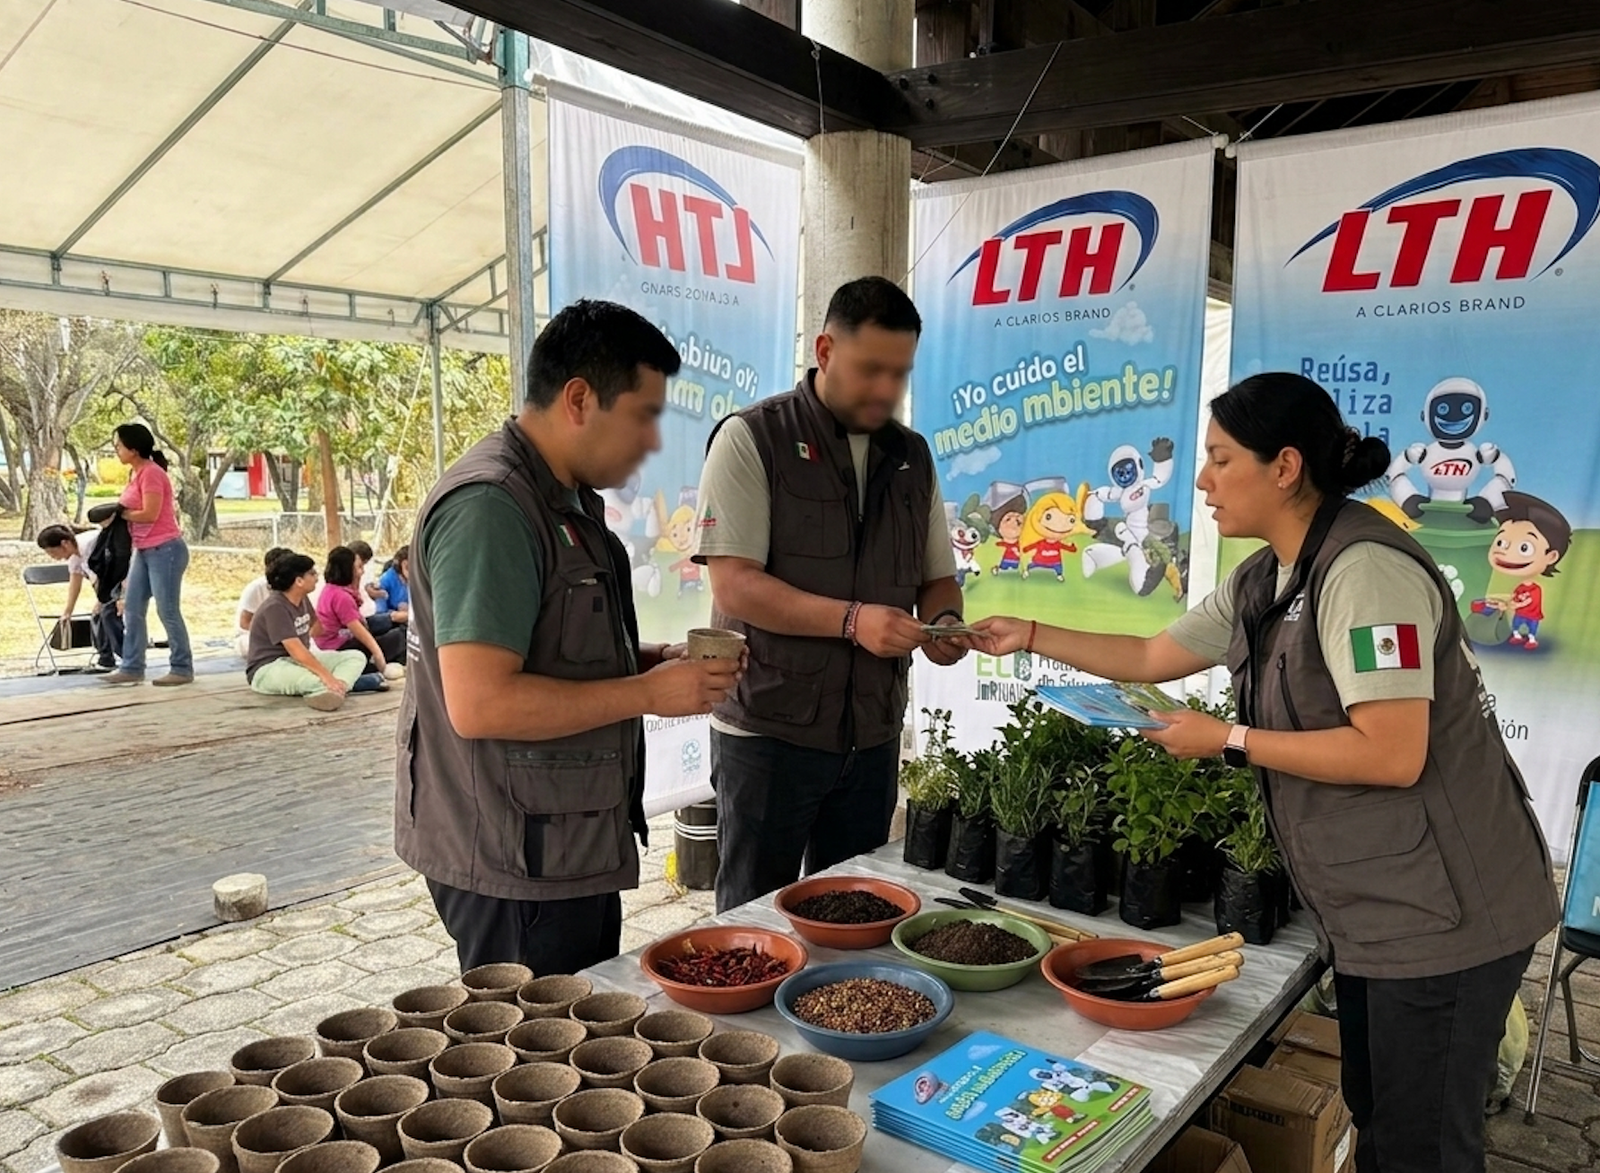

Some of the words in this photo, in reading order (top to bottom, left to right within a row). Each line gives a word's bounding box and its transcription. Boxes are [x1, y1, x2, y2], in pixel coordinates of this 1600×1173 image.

[1322, 189, 1553, 293] LTH
[972, 222, 1125, 306] LTH
[994, 318, 1002, 328] A
[1006, 312, 1060, 327] CLARIOS
[1065, 307, 1111, 322] BRAND
[1356, 306, 1367, 318] A
[1374, 301, 1451, 317] CLARIOS
[1460, 296, 1525, 312] BRAND
[1063, 345, 1085, 373] el
[1301, 354, 1390, 386] Reúsa,
[934, 404, 1018, 455] medio
[1023, 364, 1173, 424] mbiente!
[1333, 388, 1393, 415] liza
